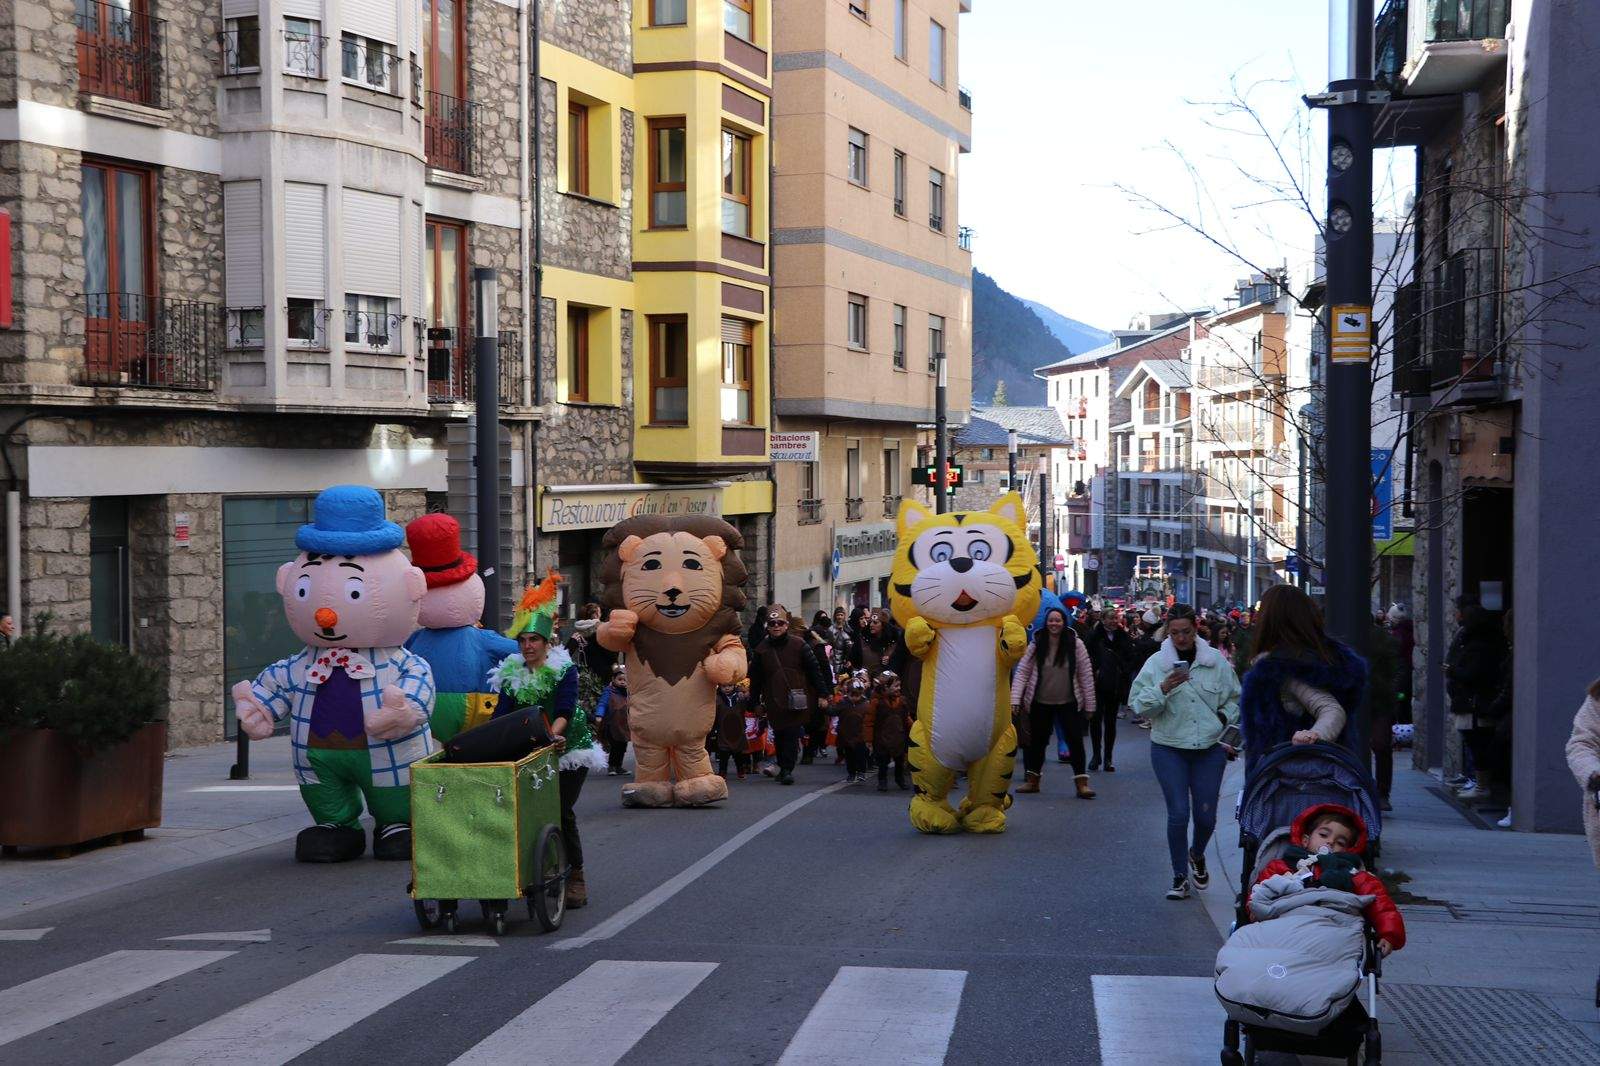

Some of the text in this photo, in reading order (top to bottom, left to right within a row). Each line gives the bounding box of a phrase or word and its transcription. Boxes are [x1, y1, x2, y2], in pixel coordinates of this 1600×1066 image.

[769, 434, 811, 442] bitacions
[769, 451, 813, 460] staurant
[547, 498, 627, 526] Restaurant
